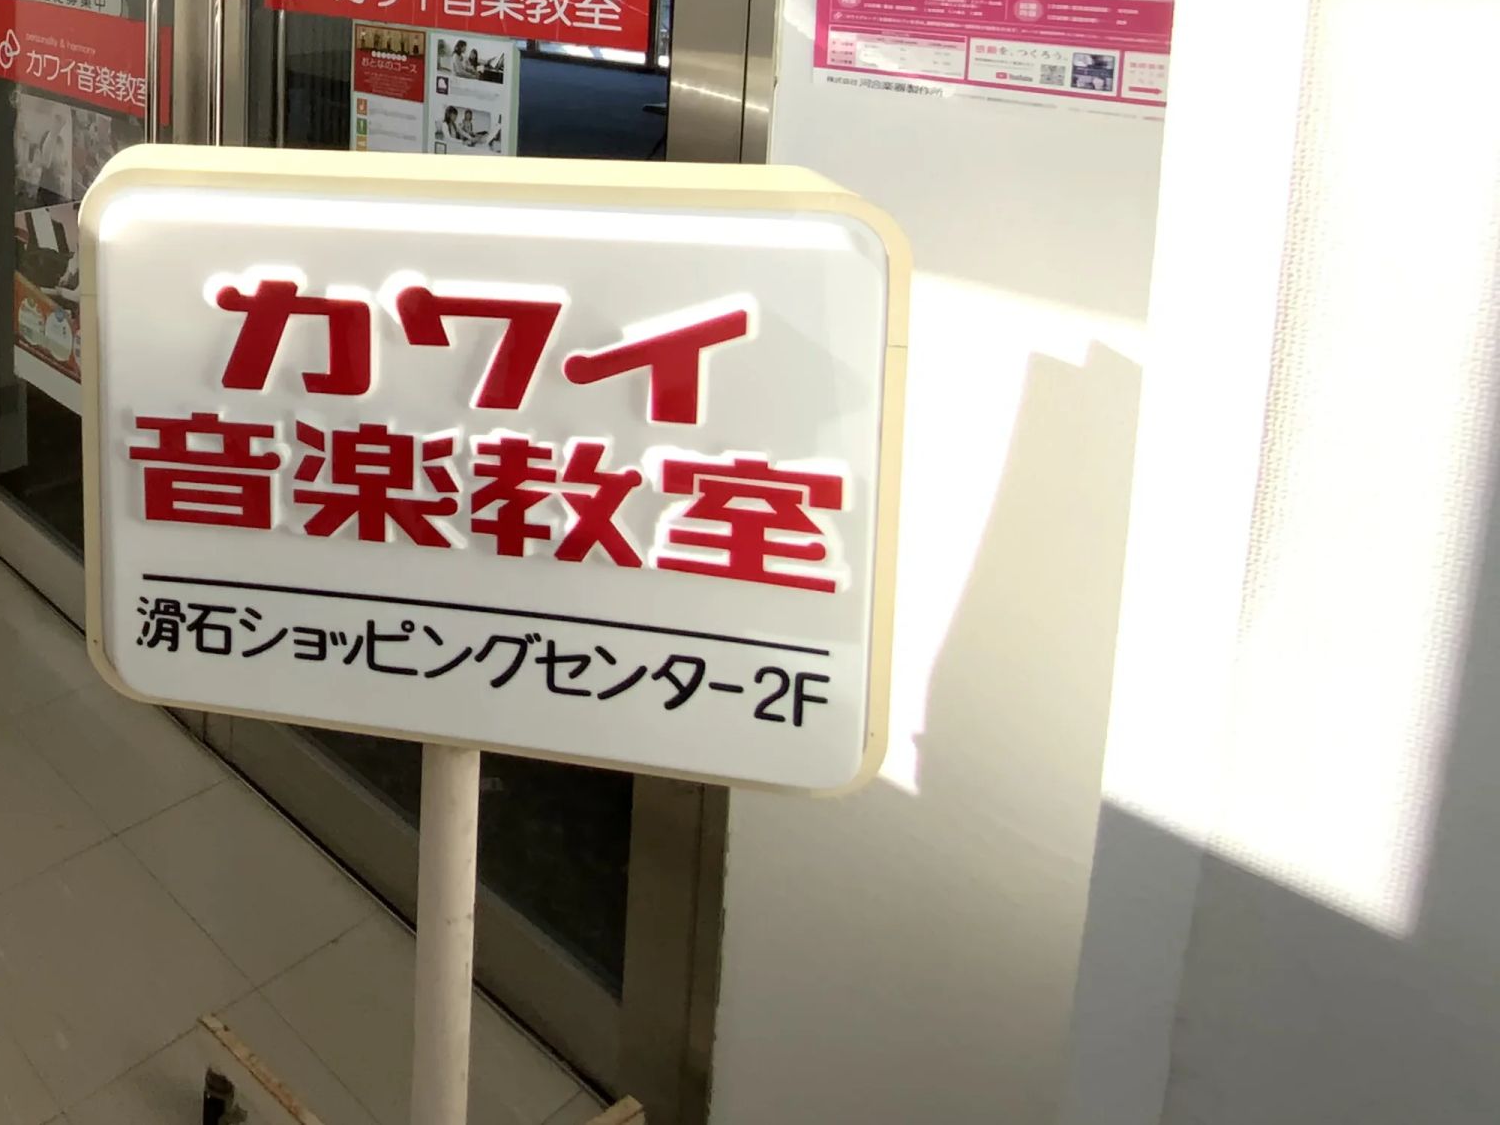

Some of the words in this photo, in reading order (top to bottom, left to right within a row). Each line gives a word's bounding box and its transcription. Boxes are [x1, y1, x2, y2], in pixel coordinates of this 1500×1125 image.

[216, 280, 748, 425] カワイ
[129, 411, 843, 594] 音楽教室
[136, 596, 829, 727] 滑石ショッピングセンター2F
